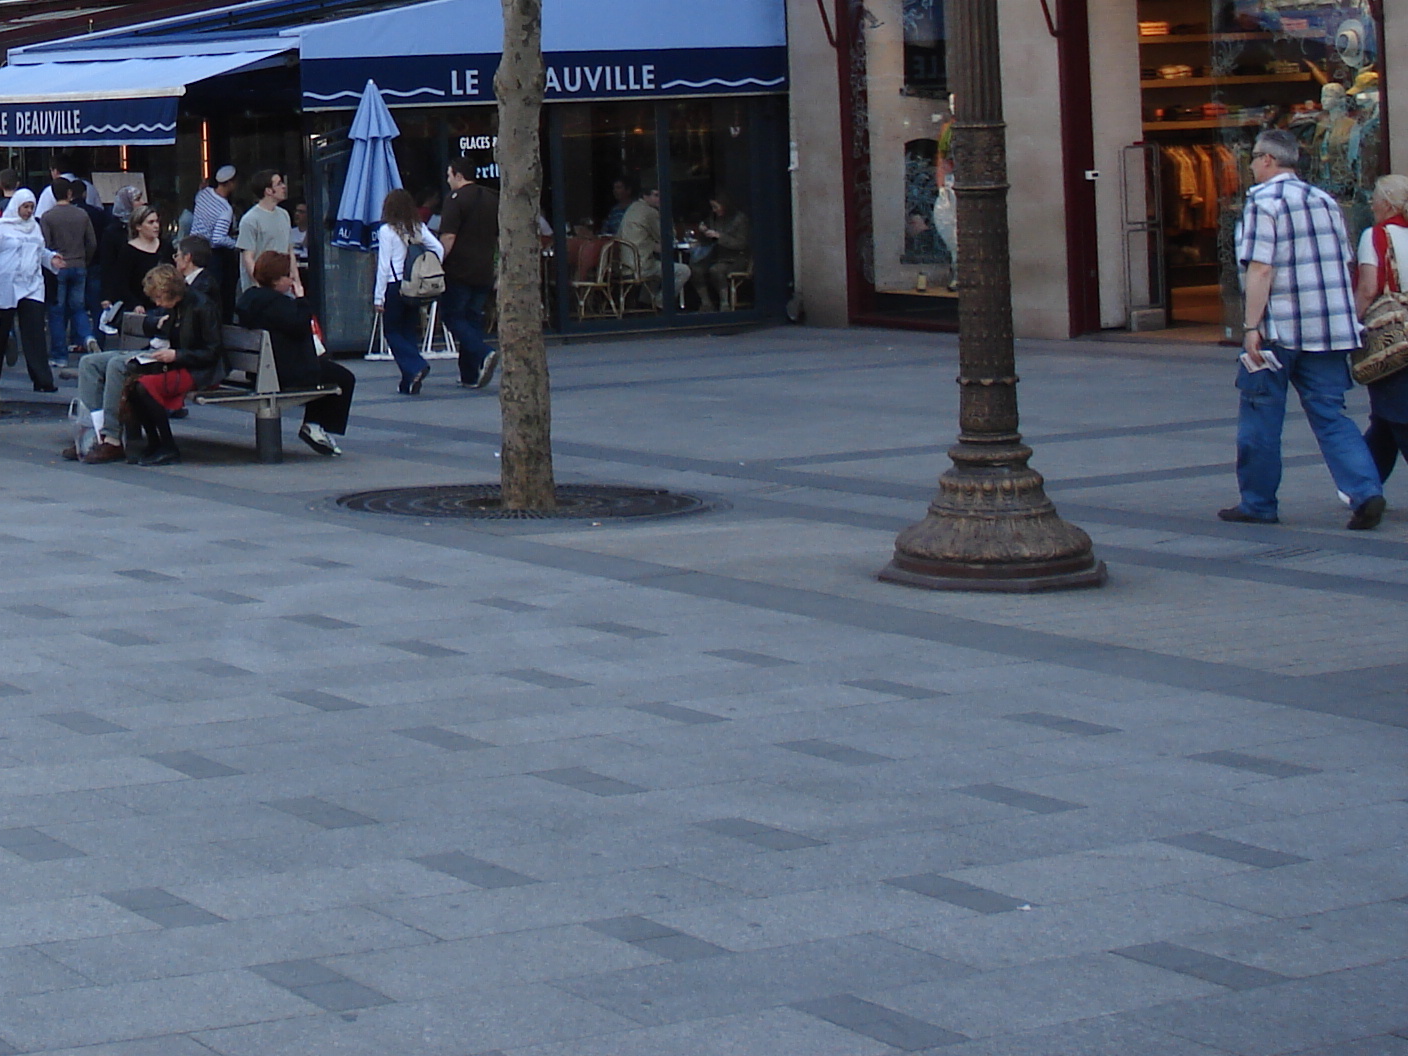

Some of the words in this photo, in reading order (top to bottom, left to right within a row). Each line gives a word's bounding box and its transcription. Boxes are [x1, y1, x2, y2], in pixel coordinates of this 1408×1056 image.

[451, 69, 479, 95] LE
[543, 64, 656, 93] AUVILLE
[16, 109, 81, 135] DEAUVILLE
[459, 136, 491, 150] GLACES
